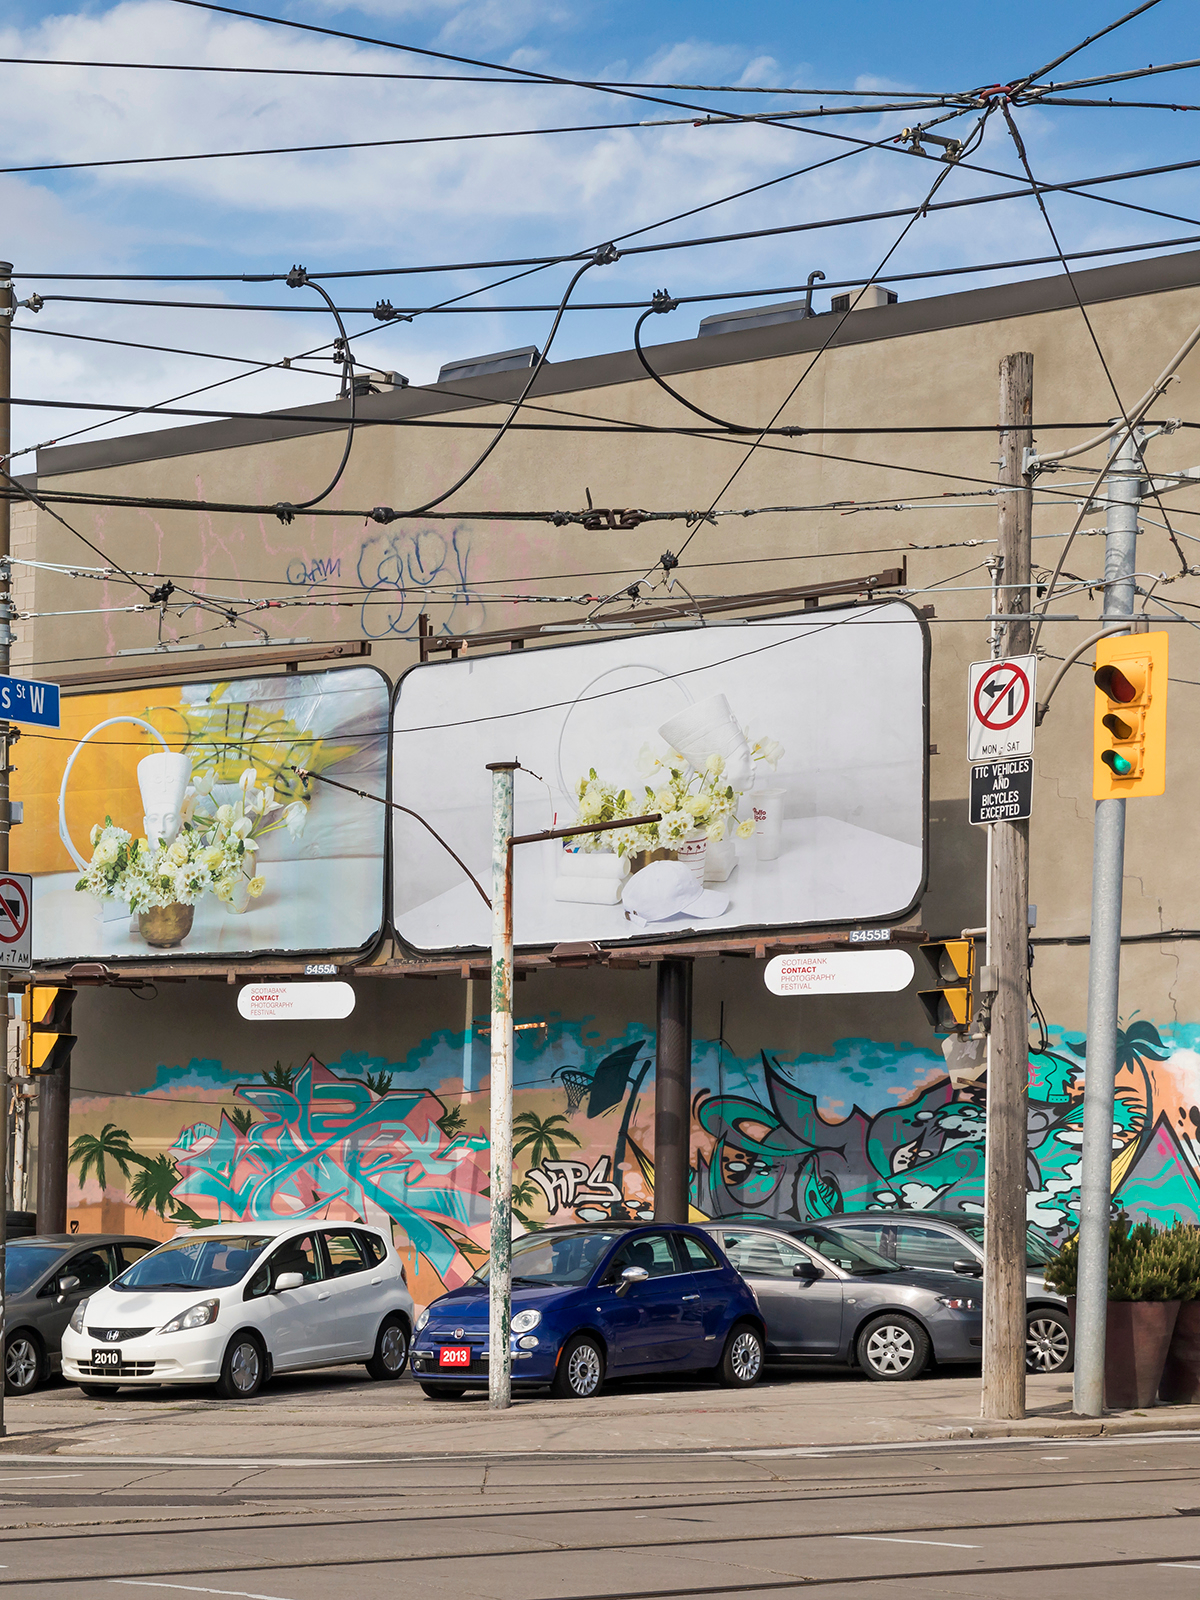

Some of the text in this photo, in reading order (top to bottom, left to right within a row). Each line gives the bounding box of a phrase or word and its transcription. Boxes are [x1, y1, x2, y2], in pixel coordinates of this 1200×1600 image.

[16, 683, 26, 699] St
[29, 685, 45, 714] W
[982, 744, 998, 755] MON
[1006, 741, 1020, 752] SAT
[975, 760, 1029, 779] TTC VEHICLES
[992, 777, 1010, 791] AND
[982, 790, 1019, 807] BICYCLES
[980, 803, 1020, 820] EXCEPTED
[851, 929, 889, 942] 5455B
[781, 958, 828, 966] SCOTIABANK
[305, 964, 336, 974] 5455A
[781, 966, 817, 974] CONTACT
[781, 974, 836, 982] PHOTOGRAPHY
[780, 983, 812, 991] FESTIVAL
[94, 1353, 119, 1364] 2010
[443, 1350, 467, 1362] 2013
